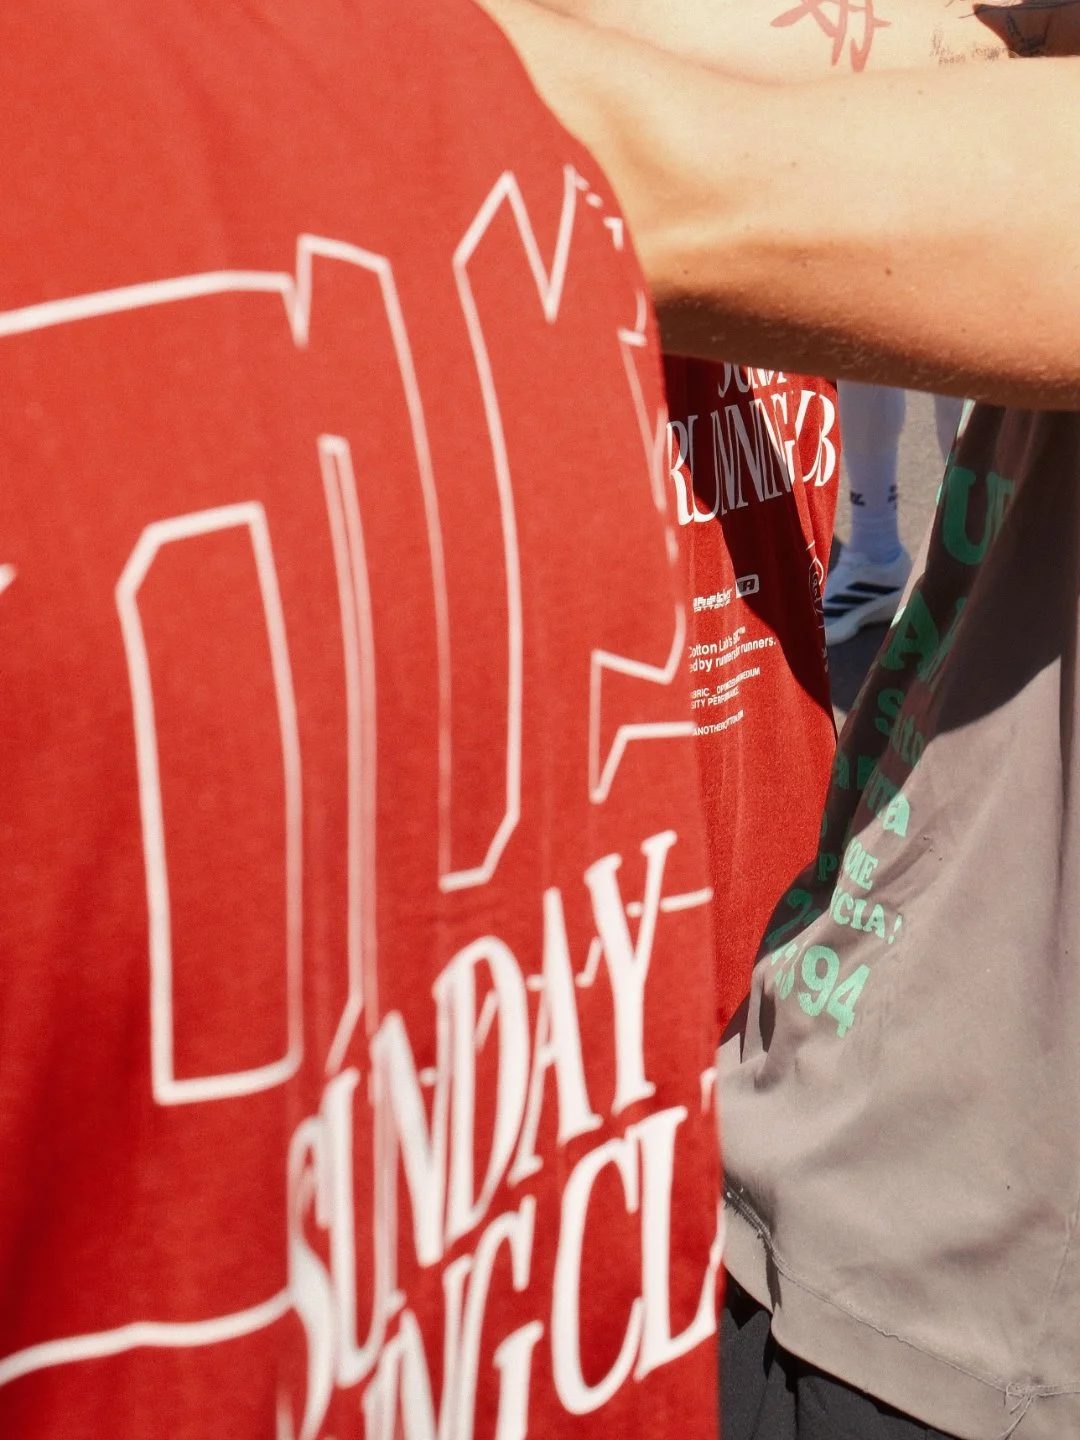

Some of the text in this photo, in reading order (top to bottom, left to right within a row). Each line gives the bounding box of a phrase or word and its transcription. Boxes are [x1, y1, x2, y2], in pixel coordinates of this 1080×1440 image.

[700, 658, 713, 673] by
[741, 636, 777, 653] runners.
[691, 687, 710, 699] BRIC
[829, 888, 903, 945] CIA!
